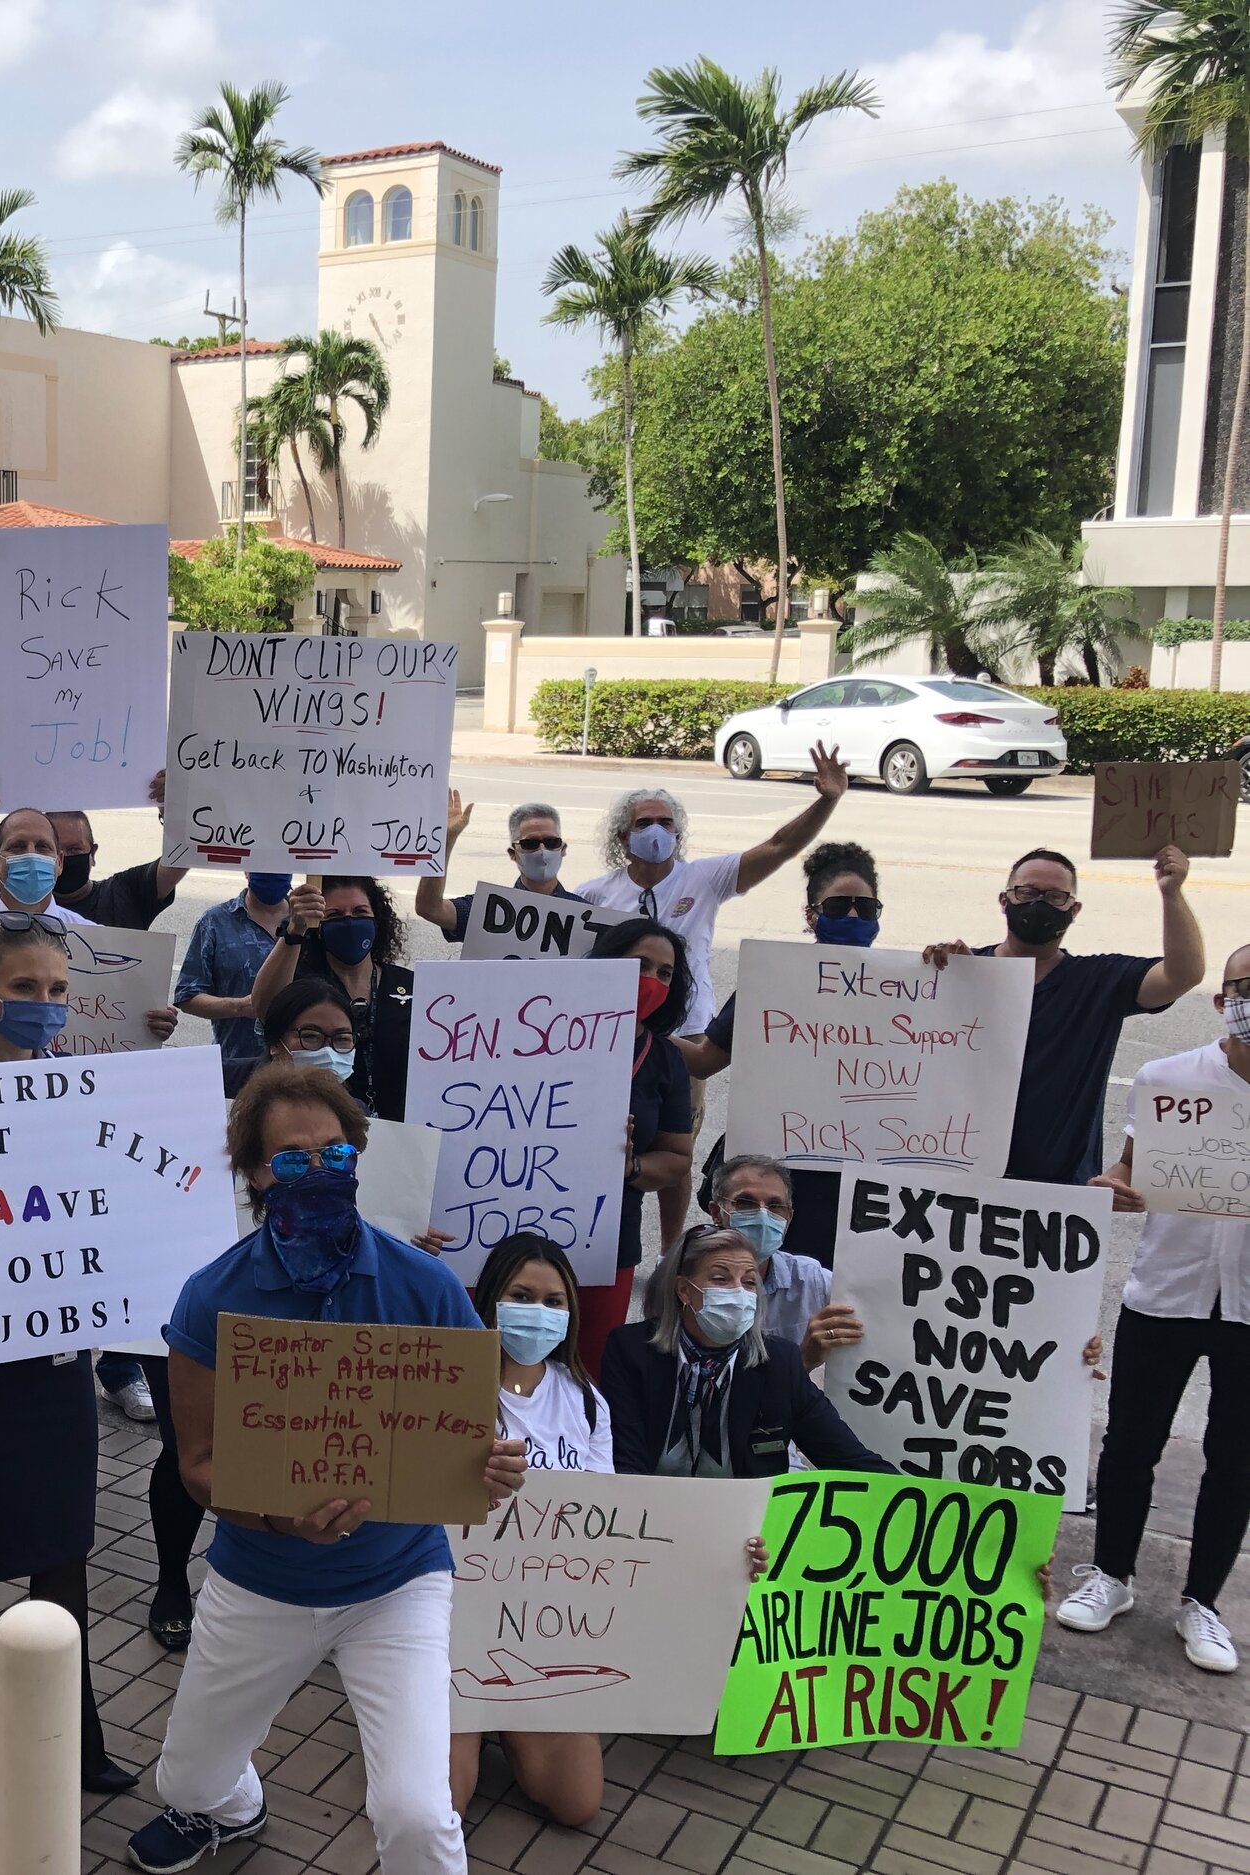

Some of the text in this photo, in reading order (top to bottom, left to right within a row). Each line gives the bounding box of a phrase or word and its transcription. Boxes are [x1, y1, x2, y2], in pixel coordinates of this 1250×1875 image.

[369, 287, 381, 298] XII
[20, 635, 109, 680] SAVE
[30, 705, 132, 768] Job!
[177, 733, 220, 771] Get
[231, 739, 285, 771] back
[189, 806, 256, 846] Save
[281, 816, 352, 854] OUR
[483, 893, 619, 956] DON'T
[66, 993, 126, 1021] KERS
[418, 994, 501, 1062] SEN.
[513, 994, 636, 1058] SCOTT
[763, 1010, 985, 1058] PAYROLL Support
[837, 1058, 922, 1089] NOW
[425, 1081, 579, 1132] SAVE
[1152, 1095, 1213, 1125] PSP
[96, 1120, 202, 1193] FLY!!
[875, 1112, 981, 1160] Scott
[464, 1145, 570, 1193] OUR
[1150, 1160, 1220, 1190] SAVE
[442, 1194, 607, 1253] JOBS!
[850, 1178, 1101, 1274] EXTEND
[1186, 1192, 1250, 1214] JOB
[8, 1247, 104, 1285] OUR
[902, 1253, 1035, 1329] PSP
[1, 1297, 130, 1343] JOBS!
[353, 1330, 443, 1358] Scott
[913, 1319, 1058, 1382] NOW
[849, 1360, 1012, 1439] SAVE
[324, 1432, 379, 1458] A.A.
[558, 1435, 583, 1471] là
[900, 1437, 1067, 1496] JOBS
[291, 1459, 374, 1487] A.P.F.A.
[767, 1482, 1019, 1595] 75,000
[453, 1553, 651, 1588] SUPPORT
[498, 1600, 616, 1643] NOW
[731, 1590, 1028, 1671] AIRLINE JOBS
[754, 1665, 828, 1748] AT
